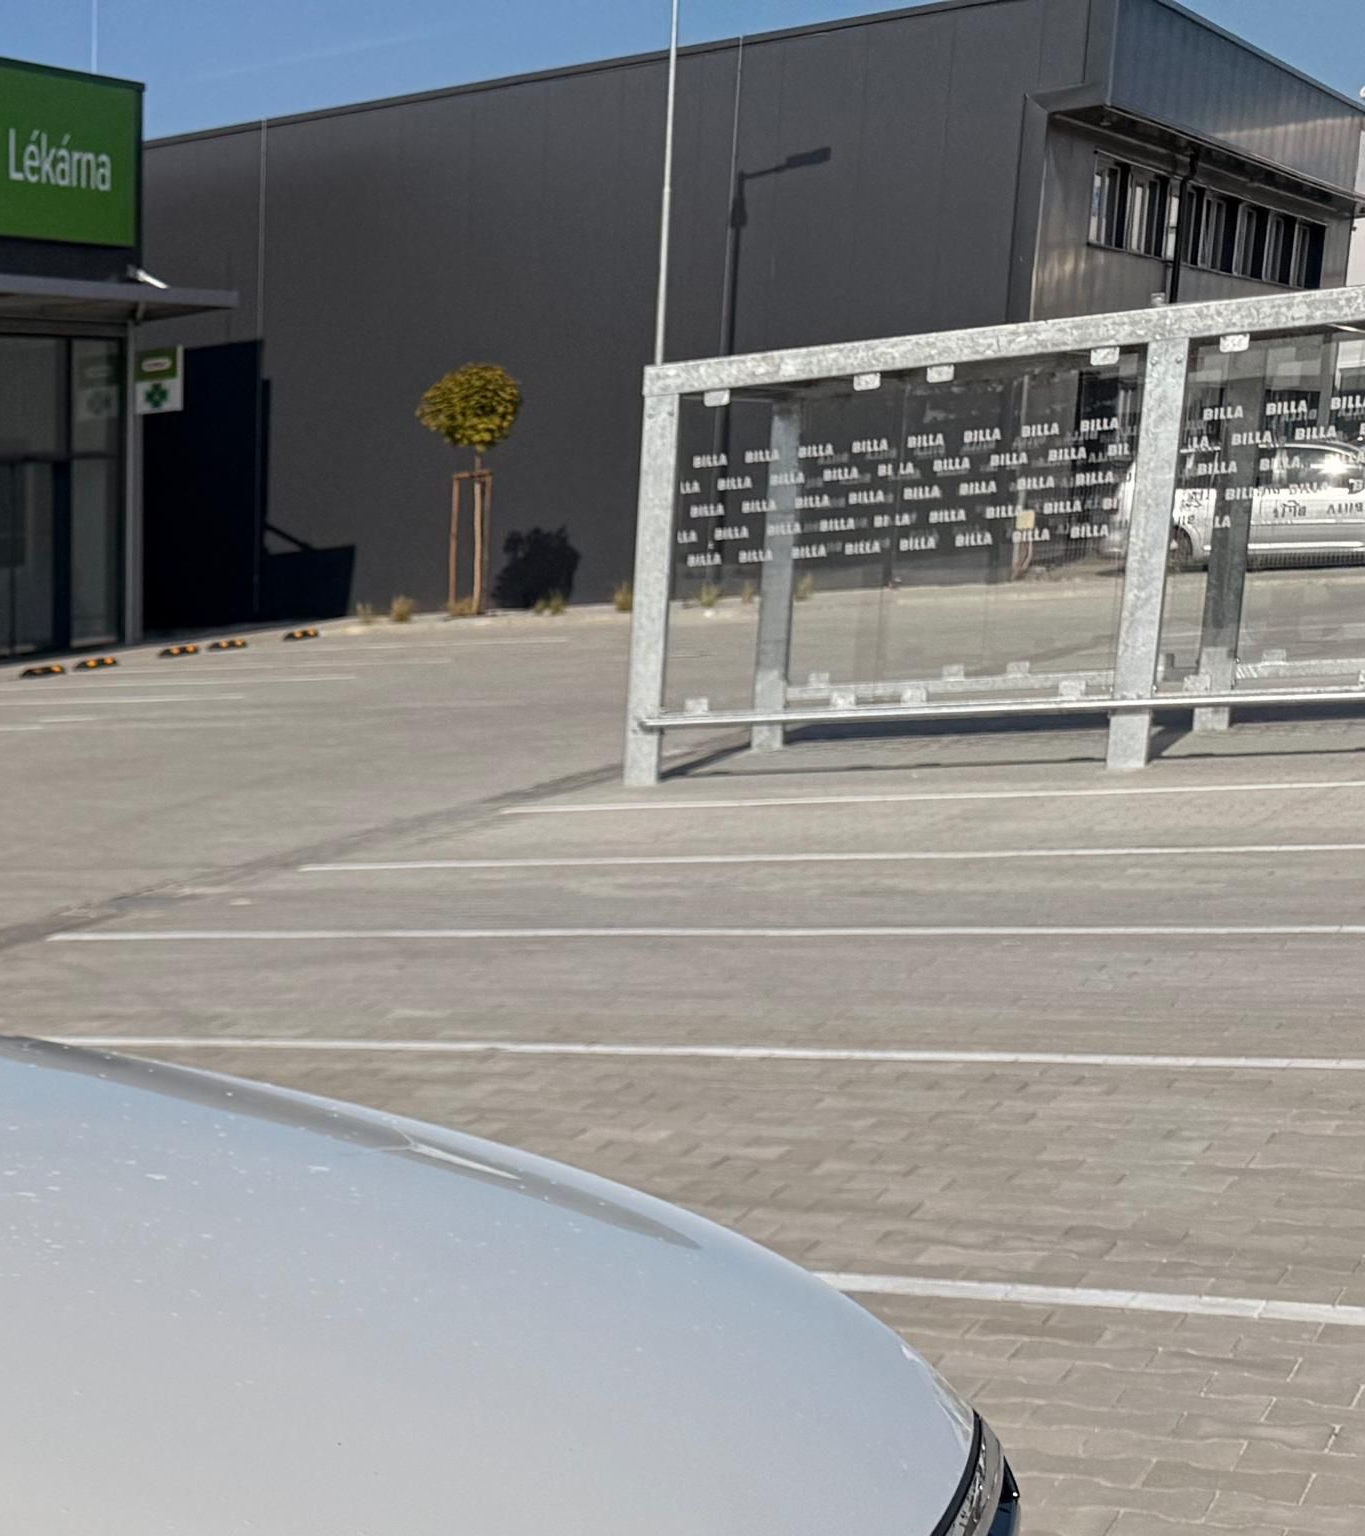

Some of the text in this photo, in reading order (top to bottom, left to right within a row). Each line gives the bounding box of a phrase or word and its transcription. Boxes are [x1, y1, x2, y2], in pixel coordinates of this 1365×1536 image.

[8, 128, 112, 191] Lékárna
[1203, 405, 1244, 421] BILLA
[1266, 399, 1308, 416] BILLA
[1330, 395, 1365, 411] BILL
[693, 453, 728, 468] BILLA
[745, 448, 780, 463] BILLA
[798, 443, 834, 459] BILLA
[852, 438, 888, 453] BILLA
[907, 433, 944, 449] BILLA
[963, 427, 1002, 443] BILLA
[1021, 422, 1059, 438] BILLA
[1080, 417, 1119, 433] BILLA
[1231, 431, 1272, 446] BILLA
[1295, 425, 1337, 440] BILLA
[717, 476, 752, 491] BILLA
[823, 466, 859, 481] BILLA
[933, 457, 970, 472] BILLA
[990, 452, 1028, 467] BILLA
[1048, 446, 1087, 461] BILLA
[1107, 443, 1130, 457] BIL
[1197, 460, 1237, 476] BILLA
[690, 470, 1114, 518] BILLA BILLA BILLA BILLA BILLA BILLA BILLA BILLA
[714, 526, 749, 541] BILLA
[819, 517, 855, 532] BILLA
[929, 508, 966, 524] BILLA
[1043, 498, 1082, 514] BILLA
[687, 524, 1109, 567] BILLA BILLA BILLA BILLA BILLA BILLA BILLA BILLA
